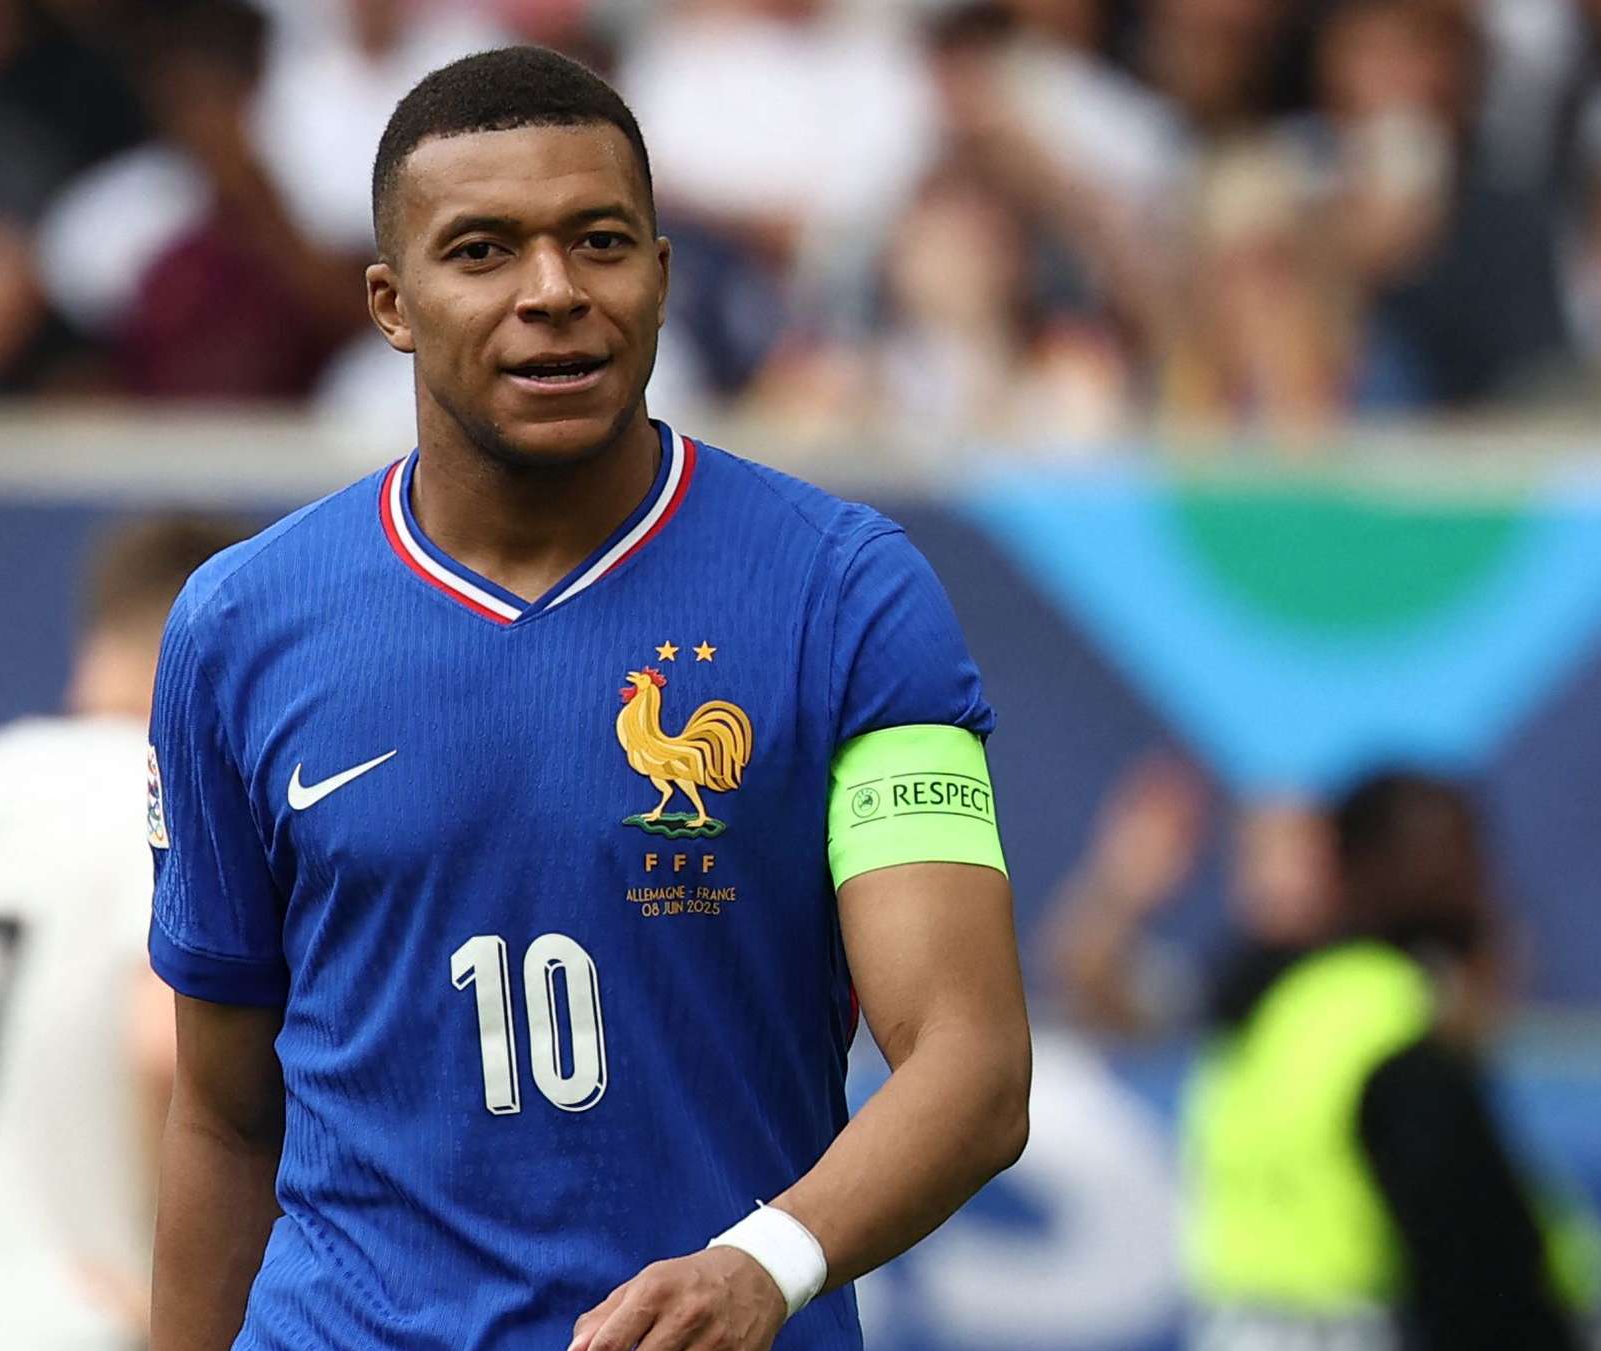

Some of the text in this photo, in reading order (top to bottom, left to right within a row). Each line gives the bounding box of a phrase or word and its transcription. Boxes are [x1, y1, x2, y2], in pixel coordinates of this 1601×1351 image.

[892, 781, 990, 815] RESPECT
[626, 885, 686, 903] ALLEMAGNE
[697, 886, 736, 901] FRANCE
[641, 899, 720, 917] 08 JUIN 2025
[451, 933, 608, 1115] 10
